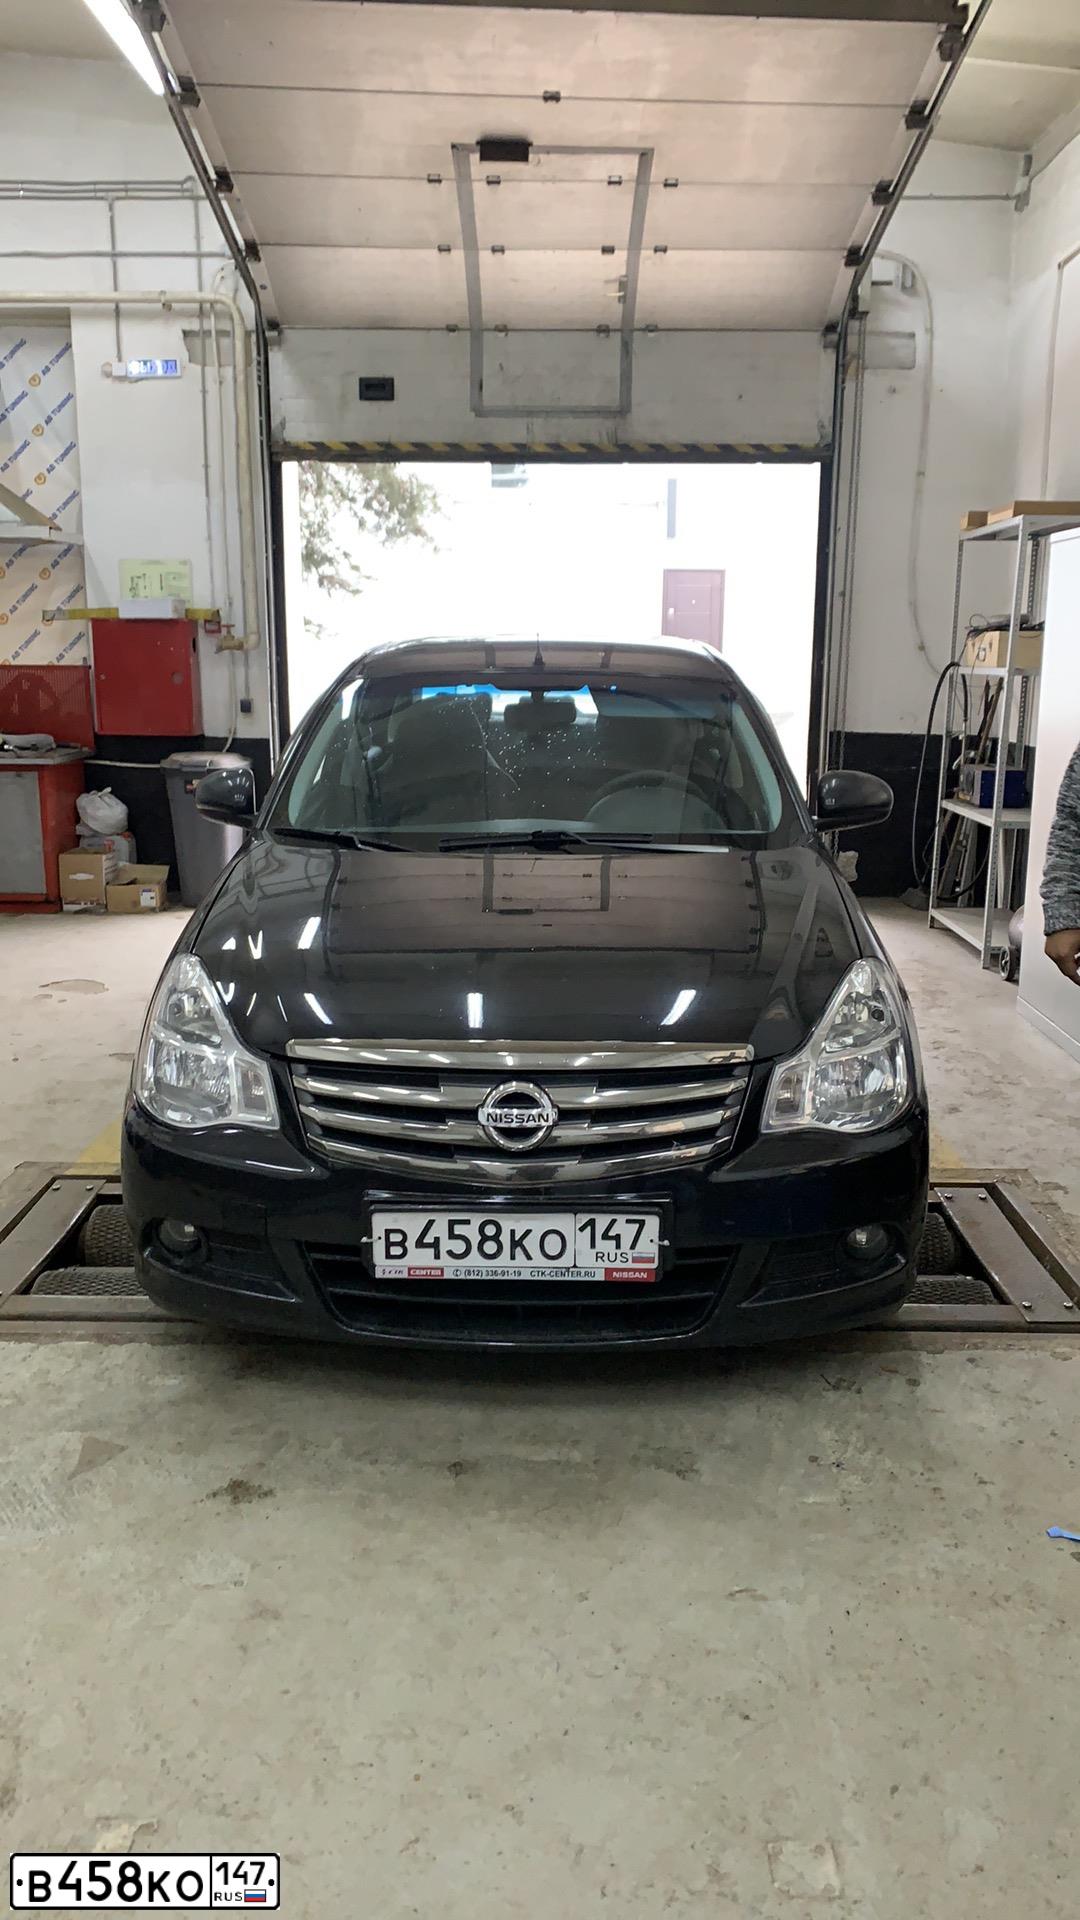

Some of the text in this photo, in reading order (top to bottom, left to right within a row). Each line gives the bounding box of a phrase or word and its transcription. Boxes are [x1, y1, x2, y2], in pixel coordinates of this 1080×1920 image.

[486, 1113, 549, 1123] NISSAN
[578, 1218, 646, 1250] 147
[595, 1252, 629, 1263] RUS
[410, 1269, 442, 1277] CENTER
[464, 1269, 483, 1278] (812)
[485, 1269, 521, 1278] 336-91-19
[530, 1270, 596, 1278] CTK-CENTER.RU
[612, 1271, 648, 1279] NISSAN
